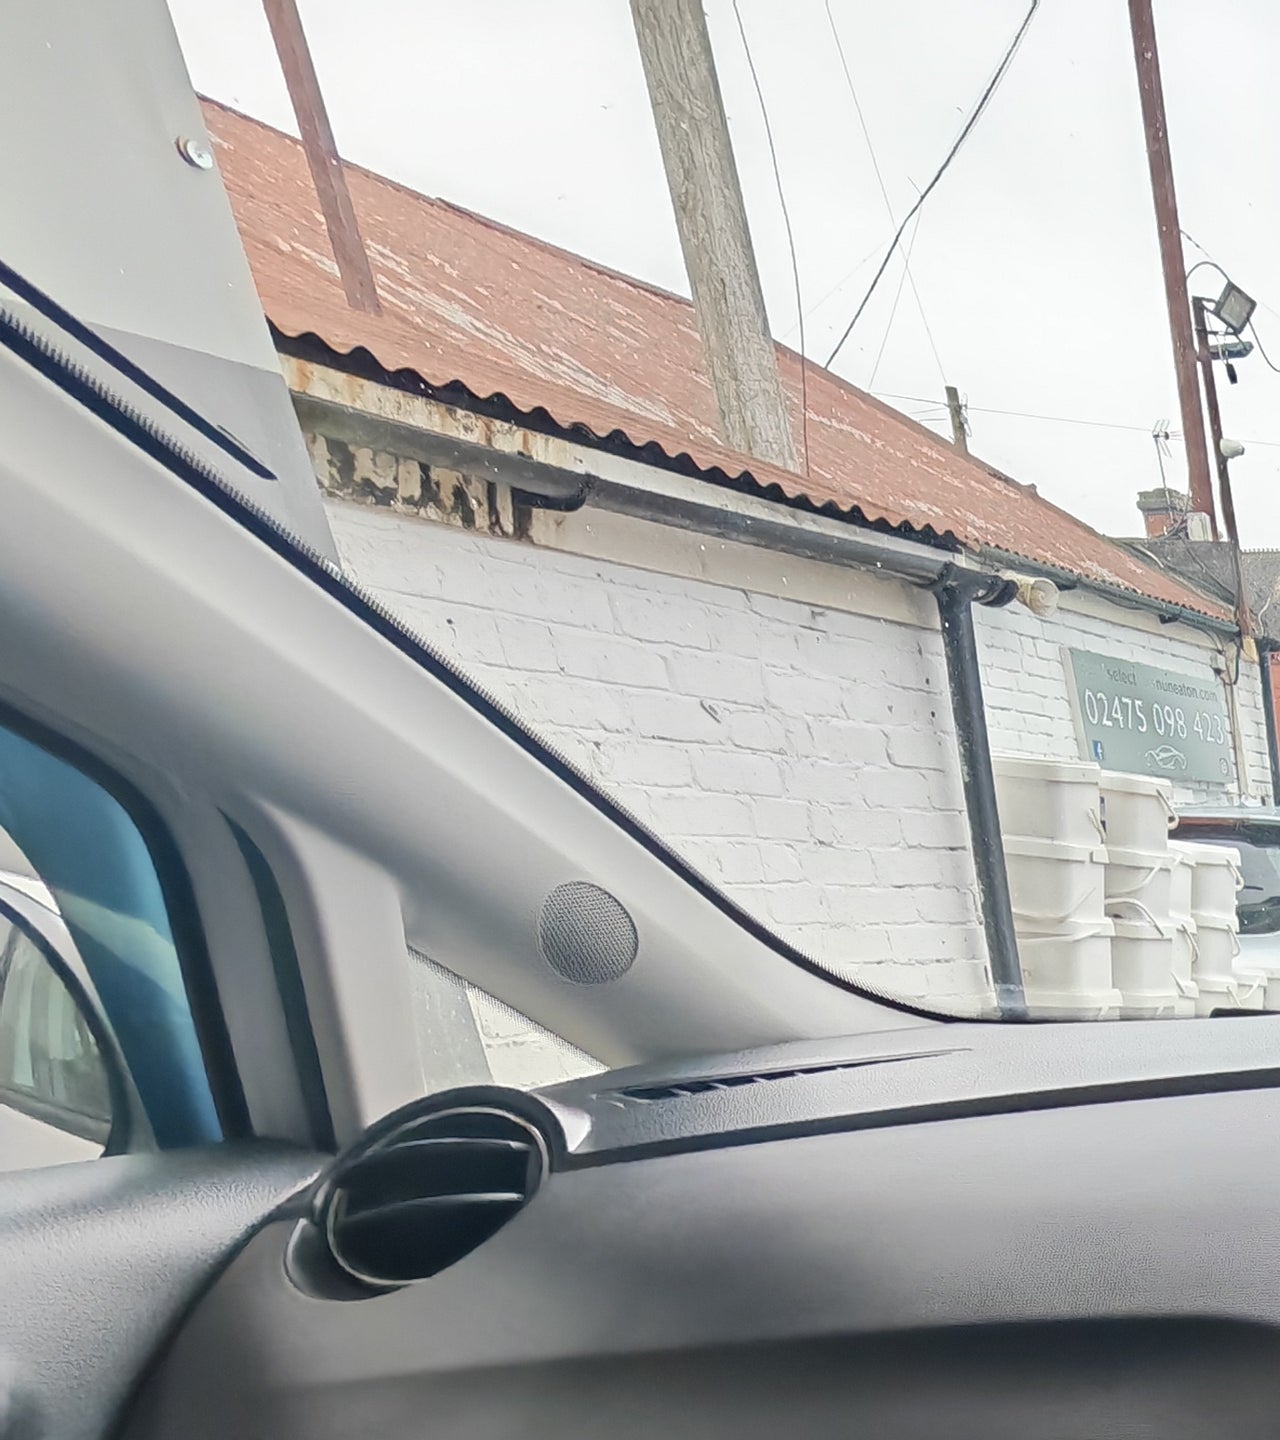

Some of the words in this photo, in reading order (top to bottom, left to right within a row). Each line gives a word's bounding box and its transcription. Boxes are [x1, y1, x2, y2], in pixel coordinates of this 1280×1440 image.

[1084, 688, 1148, 733] 02475
[1151, 702, 1188, 740] 098
[1193, 710, 1225, 745] 423
